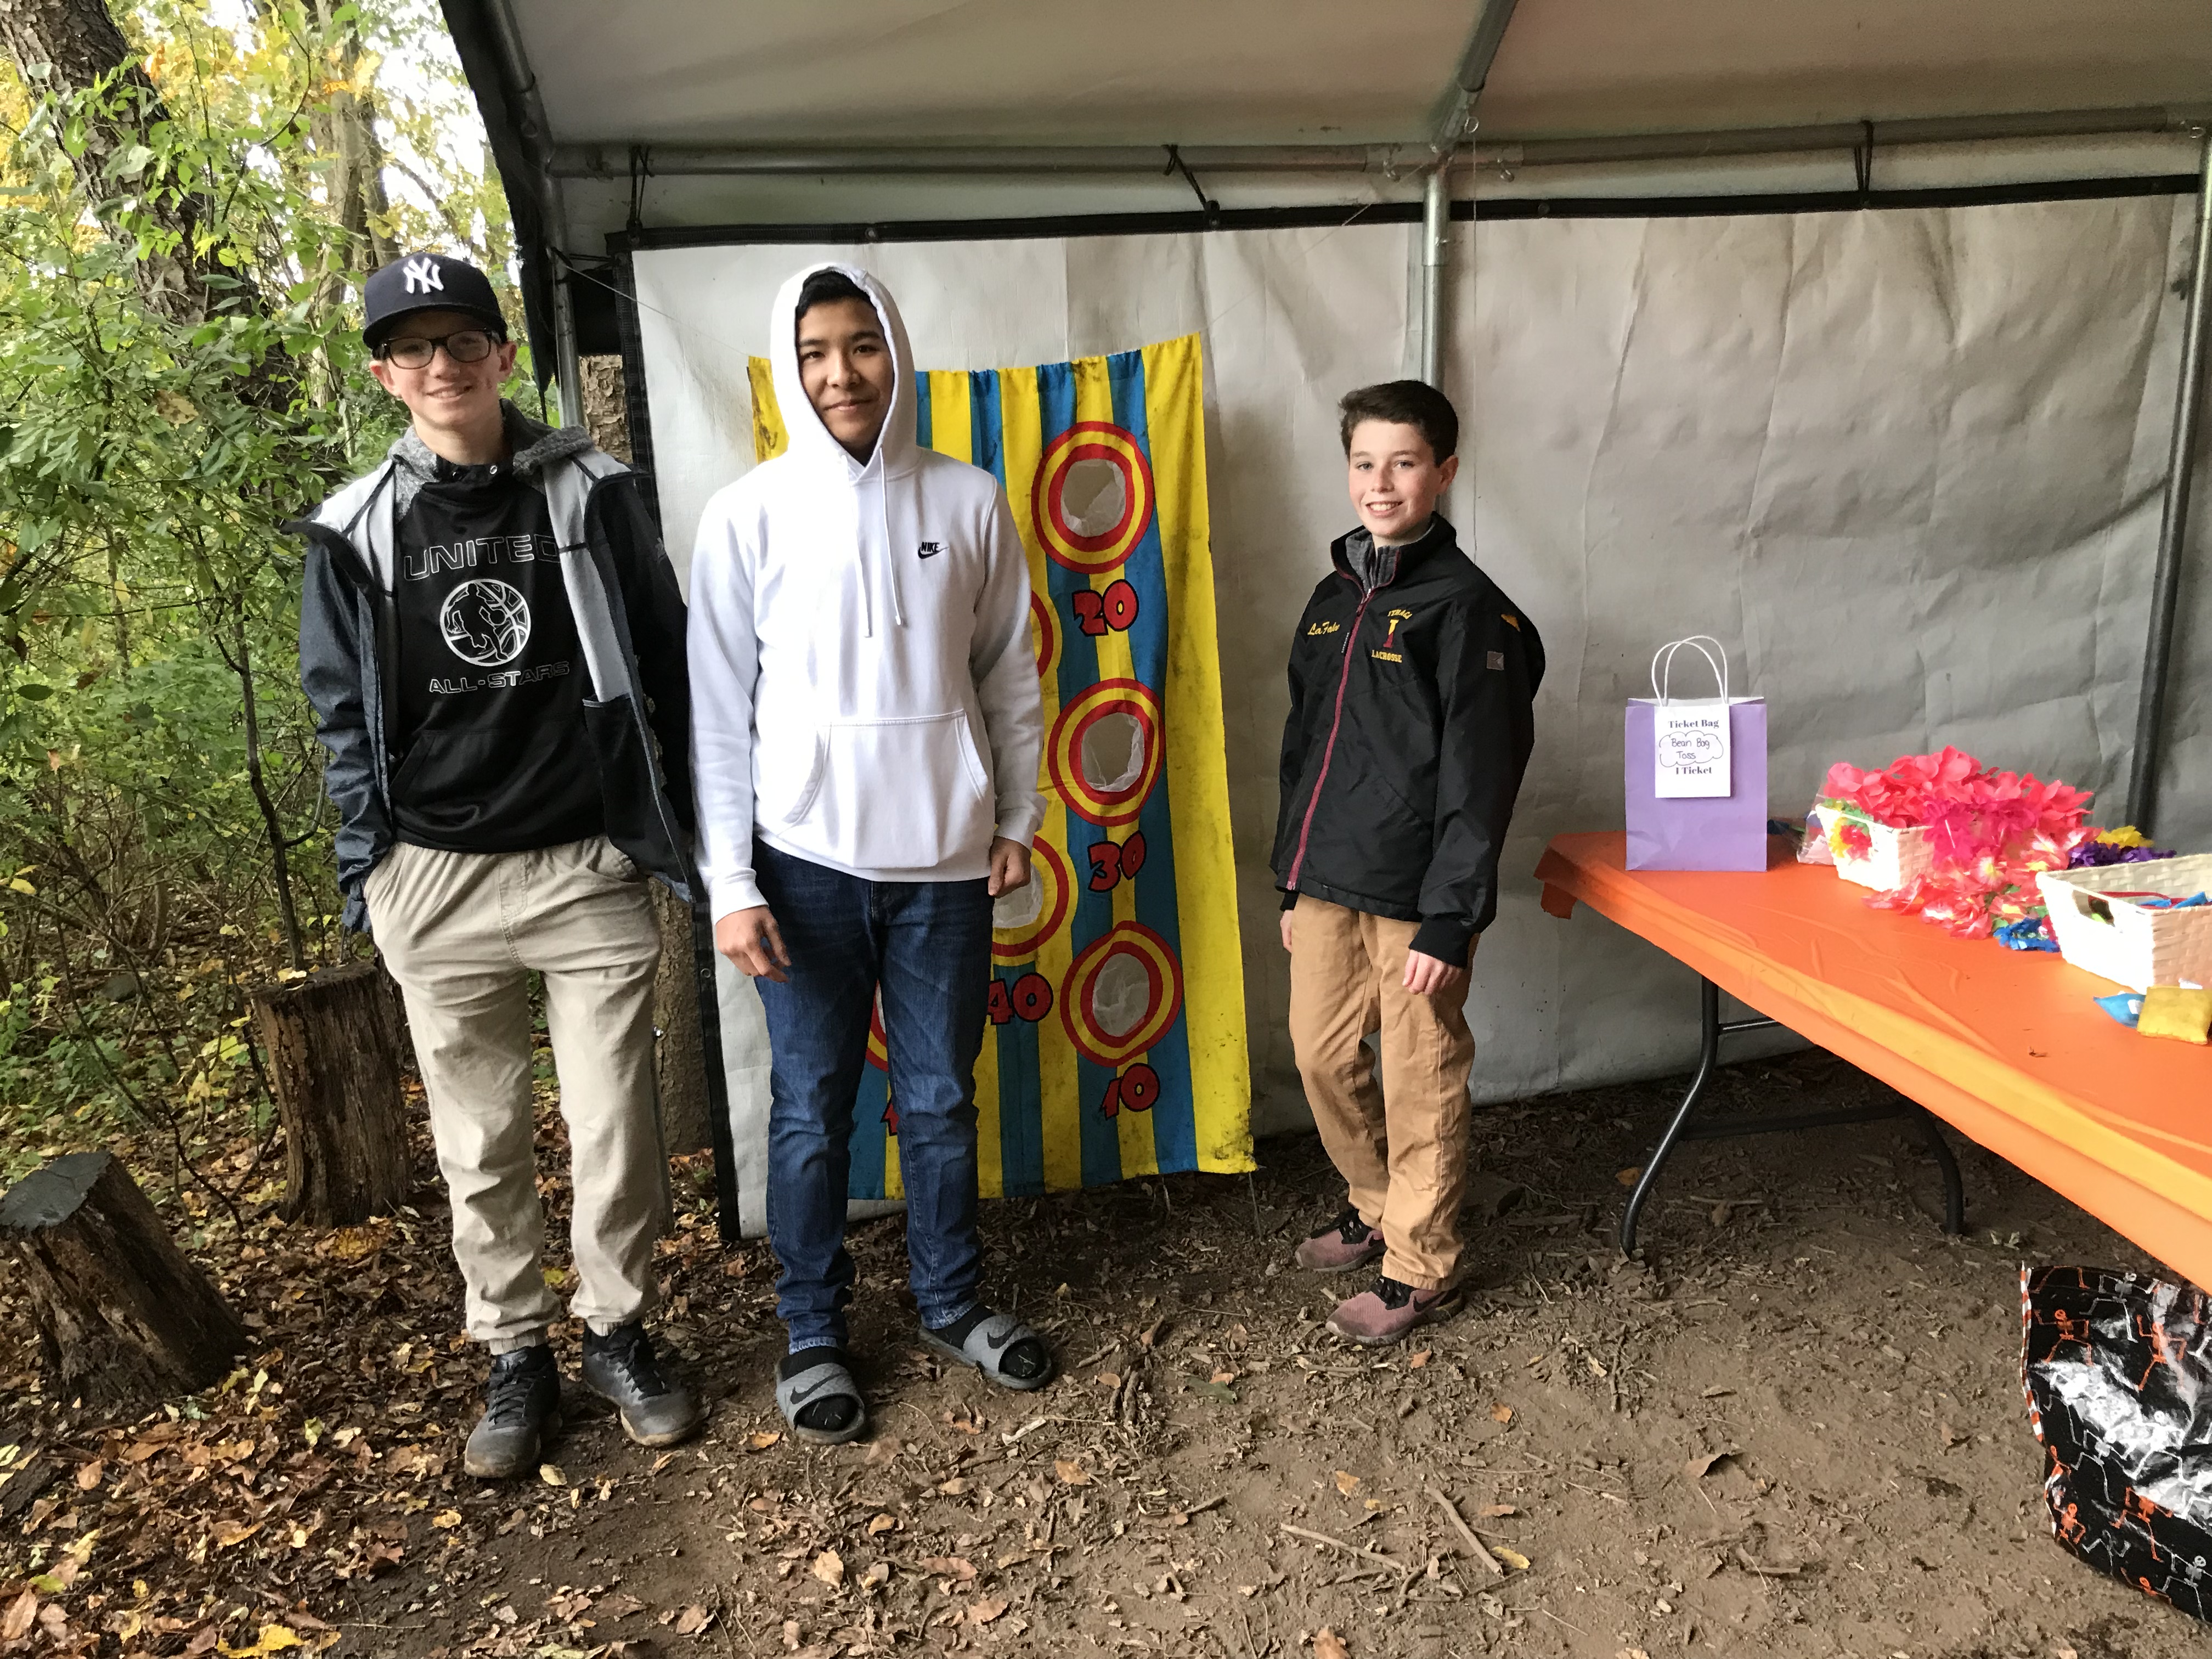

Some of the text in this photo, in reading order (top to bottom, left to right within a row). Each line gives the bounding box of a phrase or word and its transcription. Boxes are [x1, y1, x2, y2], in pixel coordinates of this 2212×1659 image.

[921, 542, 940, 552] NIKE
[404, 534, 561, 581] UNITED
[1071, 579, 1139, 637] 20
[1371, 650, 1402, 663] LACROSSE
[1668, 719, 1719, 729] Ticket Bag
[1671, 737, 1710, 749] Bean Bag
[1676, 751, 1696, 759] Toss
[1681, 766, 1712, 775] Ticket
[1088, 830, 1147, 893] 30
[987, 972, 1054, 1025] 40
[1100, 1062, 1161, 1121] 10
